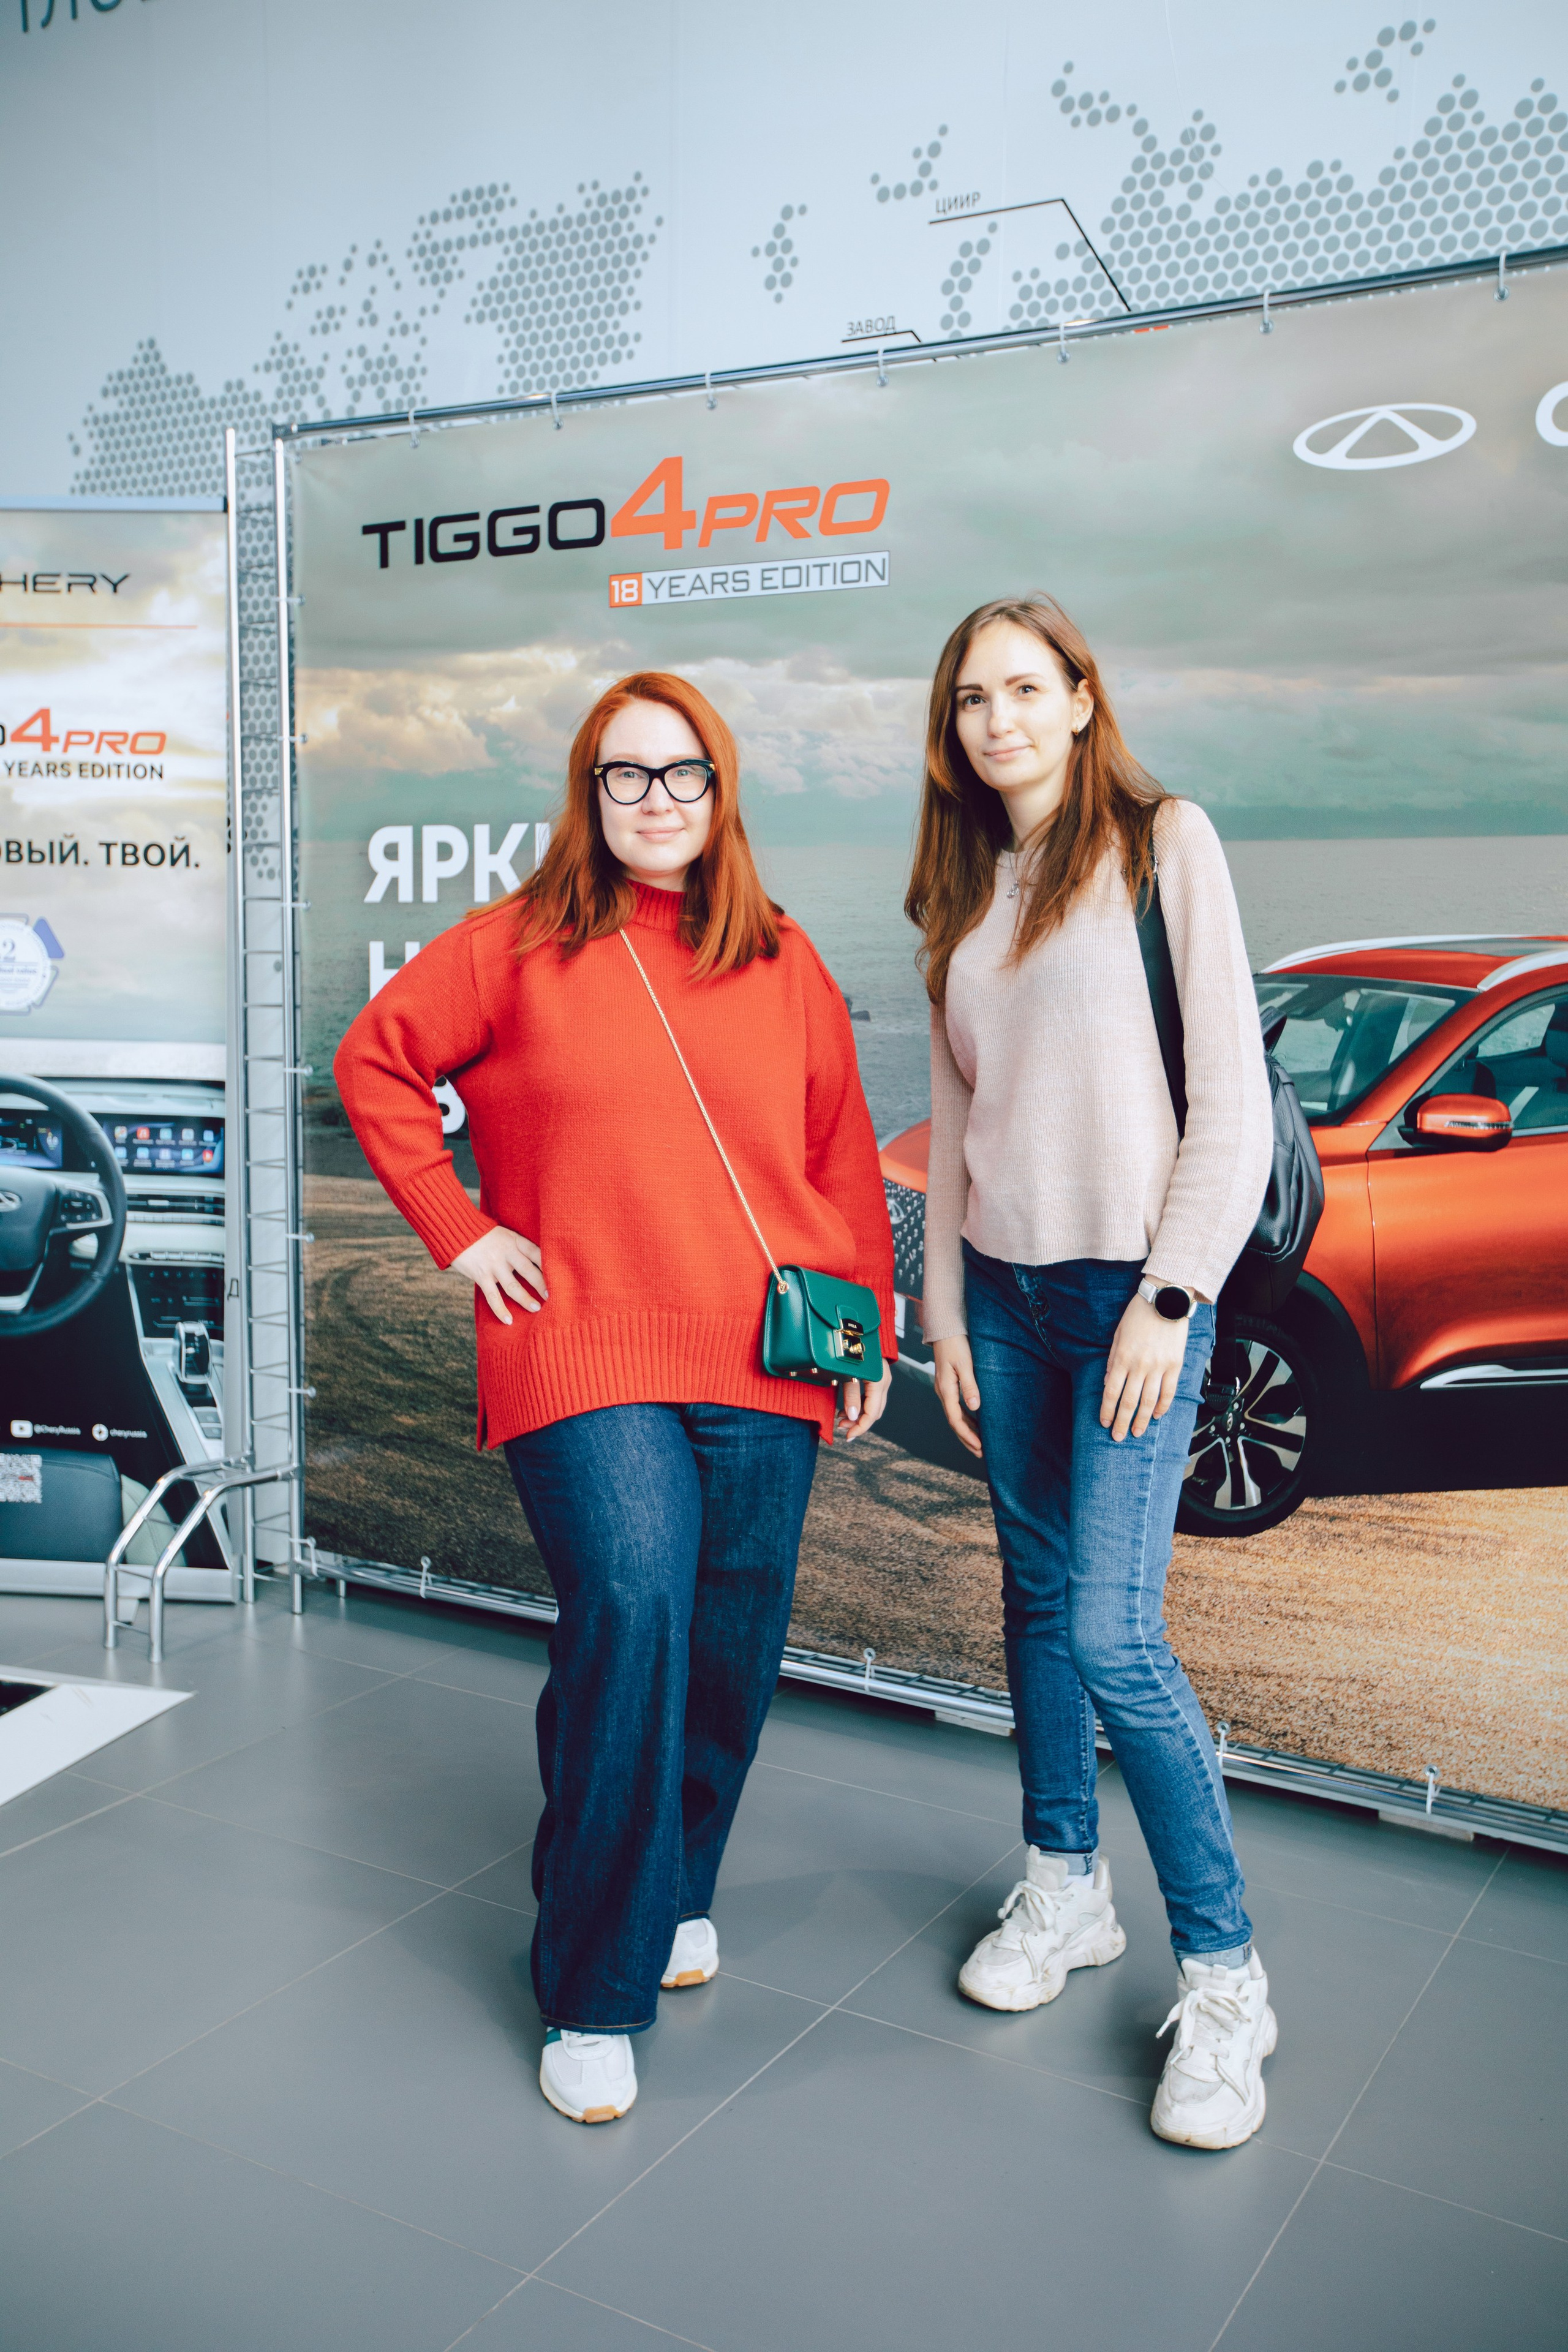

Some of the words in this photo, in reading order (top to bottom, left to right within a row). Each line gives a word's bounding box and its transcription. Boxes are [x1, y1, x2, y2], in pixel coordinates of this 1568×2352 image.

[936, 192, 981, 214] ЦИИР
[846, 315, 896, 336] ЗАВОД
[362, 498, 605, 569] TIGGO
[611, 580, 639, 603] 18
[647, 570, 750, 600] YEARS
[761, 557, 887, 591] EDITION
[4, 762, 71, 777] YEARS
[78, 763, 164, 779] EDITION
[99, 835, 200, 868] ТВОЙ.
